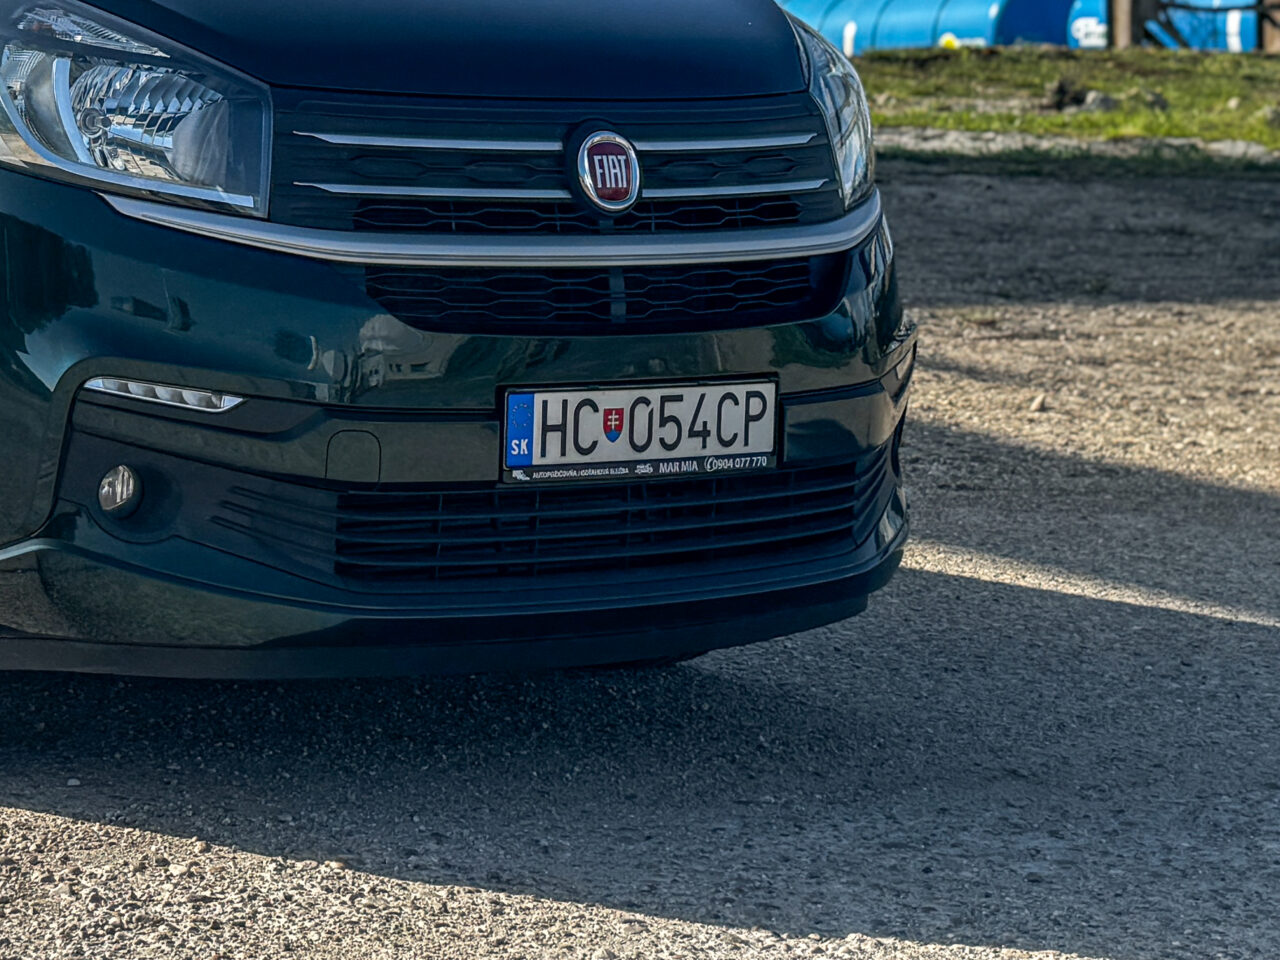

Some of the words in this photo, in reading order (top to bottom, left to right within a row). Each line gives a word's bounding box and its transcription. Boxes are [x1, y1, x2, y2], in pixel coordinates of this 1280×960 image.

[593, 155, 627, 188] FIAT
[540, 397, 600, 458] HC
[511, 439, 529, 455] SK
[734, 457, 751, 468] 077
[751, 456, 768, 467] 770
